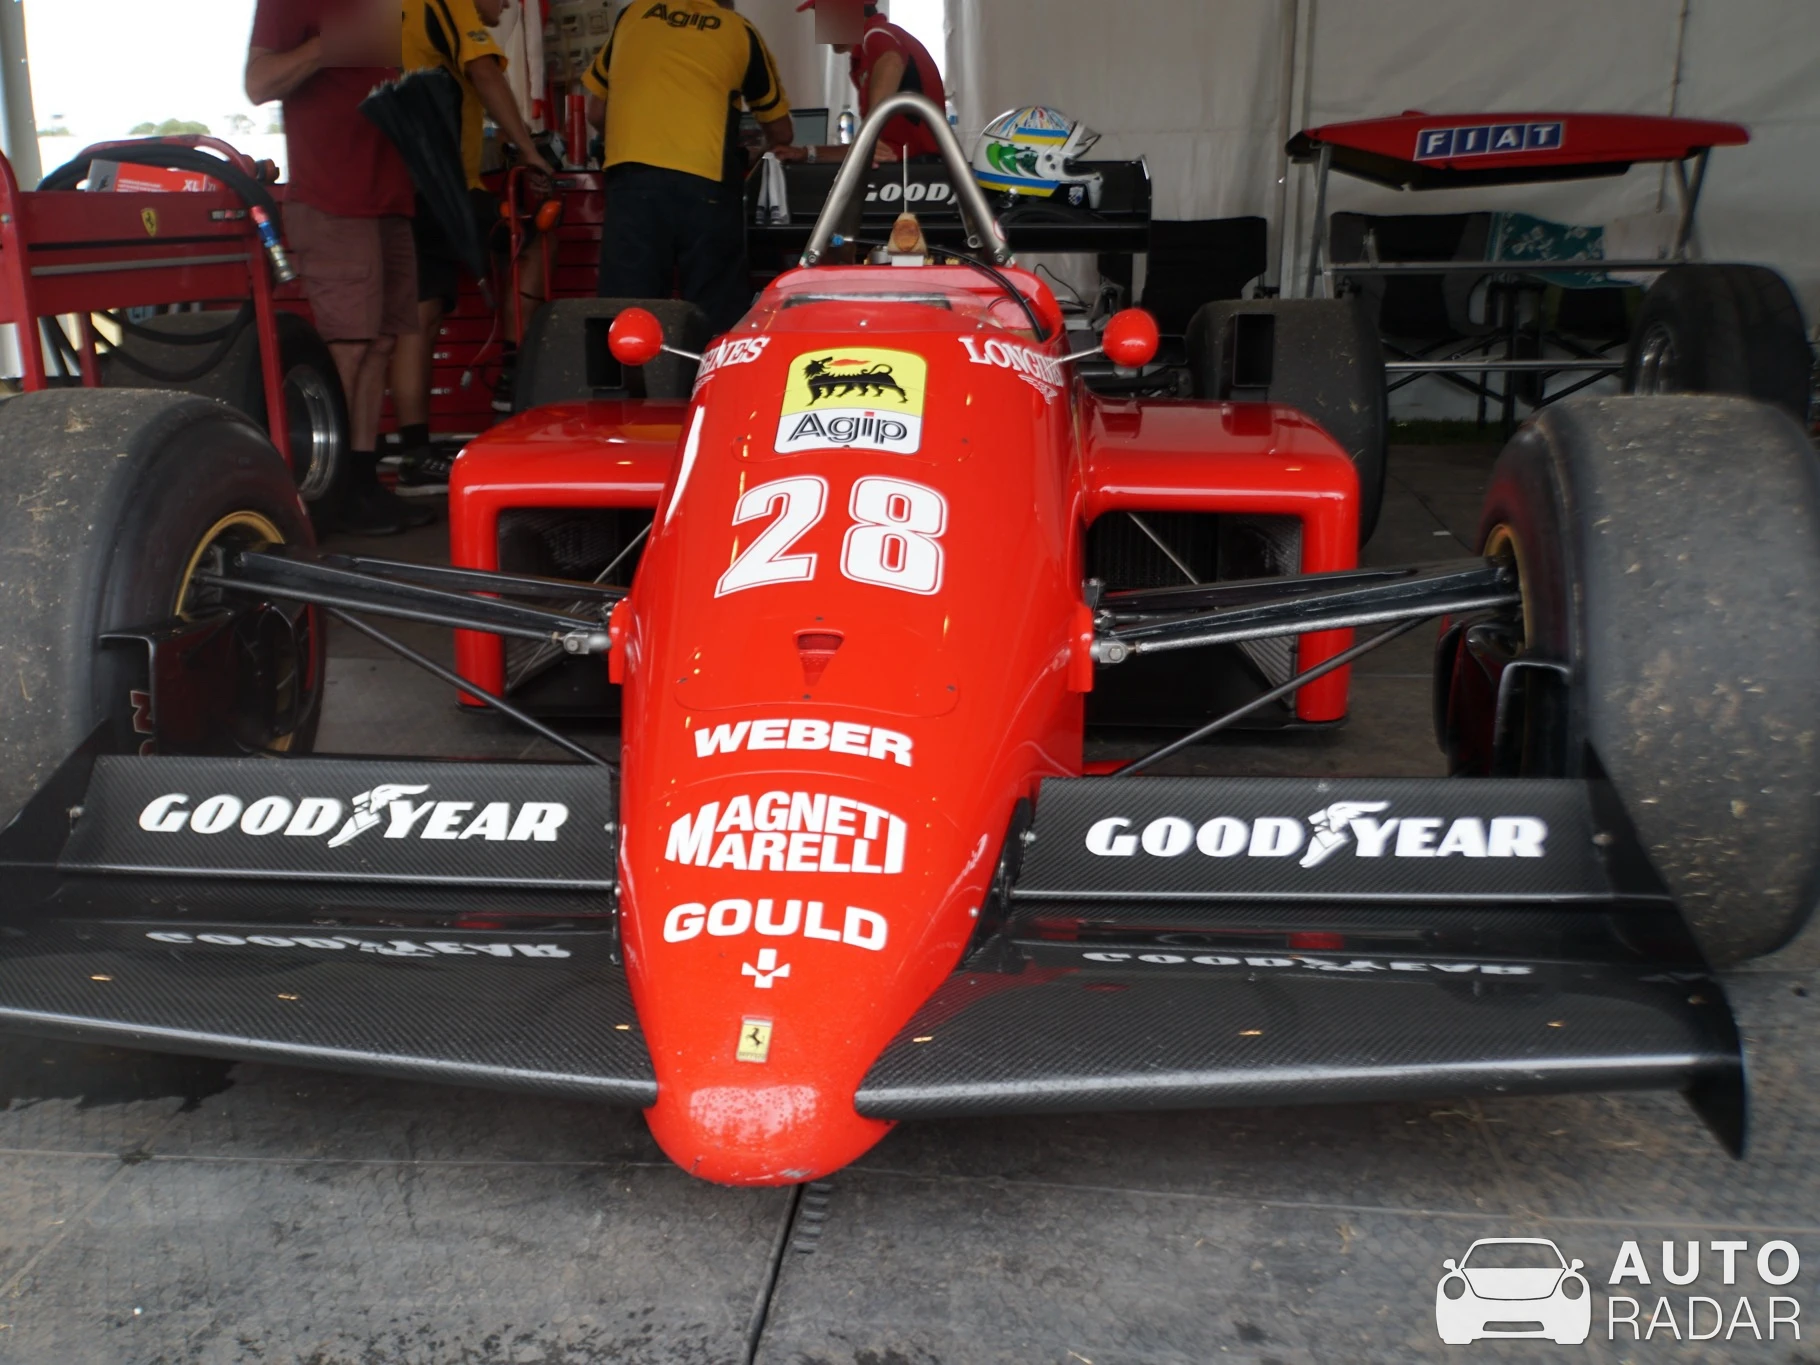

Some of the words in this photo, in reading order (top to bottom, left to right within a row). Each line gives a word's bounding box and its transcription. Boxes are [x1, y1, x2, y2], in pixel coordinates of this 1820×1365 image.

[641, 2, 722, 31] Agip
[1425, 126, 1555, 154] FIAT
[787, 411, 909, 444] Agip
[714, 474, 948, 599] 28
[694, 719, 914, 767] WEBER
[663, 898, 889, 951] GOULD
